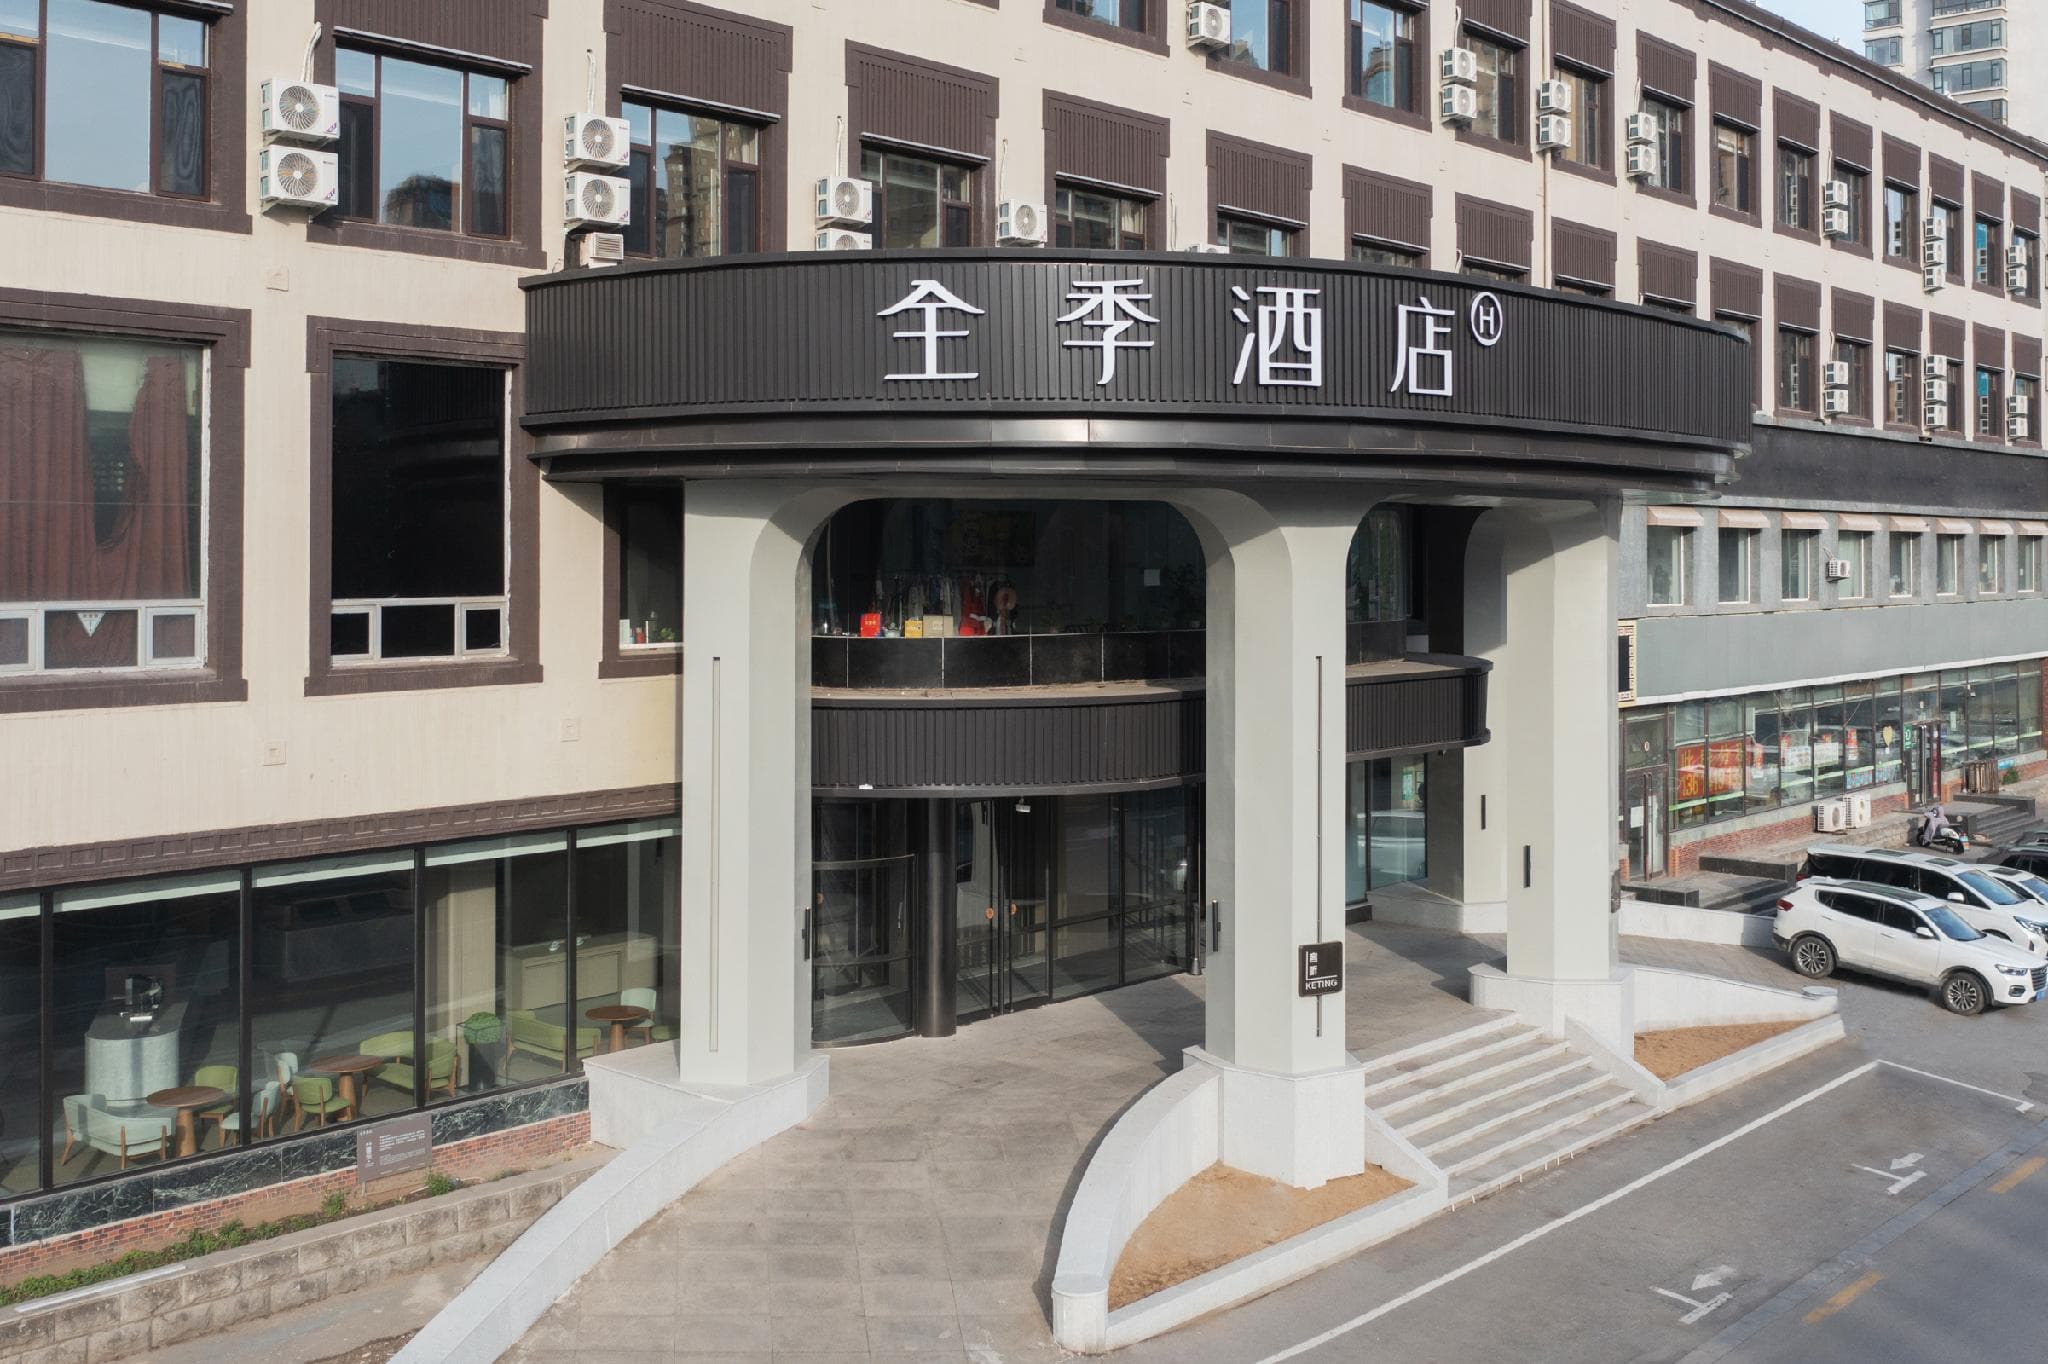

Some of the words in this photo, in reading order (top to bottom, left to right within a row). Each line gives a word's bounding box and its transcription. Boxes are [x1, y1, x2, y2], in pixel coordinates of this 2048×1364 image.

[876, 278, 1456, 397] 全季酒店
[1305, 979, 1338, 990] KETING
